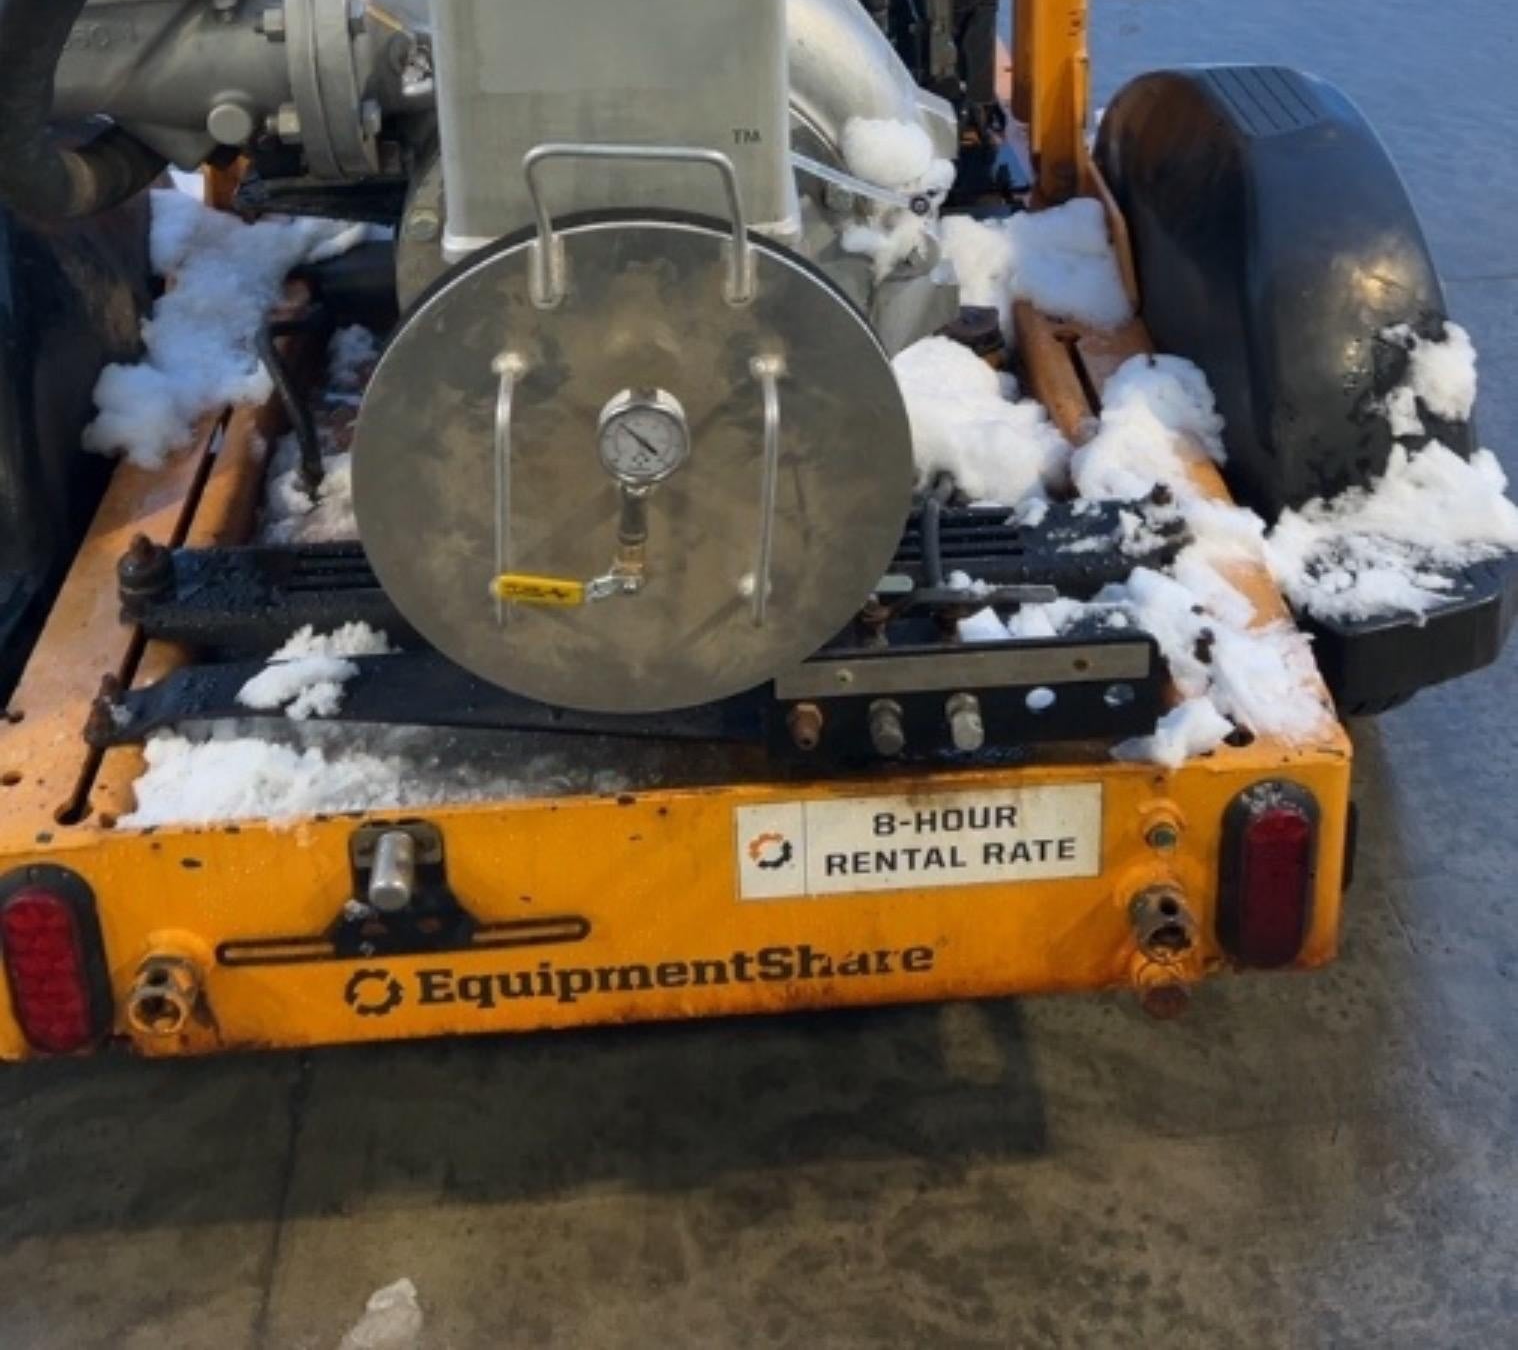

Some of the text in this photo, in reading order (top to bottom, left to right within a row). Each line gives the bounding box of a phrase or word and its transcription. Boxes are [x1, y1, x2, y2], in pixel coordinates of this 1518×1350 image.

[731, 127, 762, 146] TM
[873, 805, 1019, 838] 8-HOUR
[824, 836, 1078, 877] RENTAL RATE
[415, 944, 936, 1008] EquipmentShare
